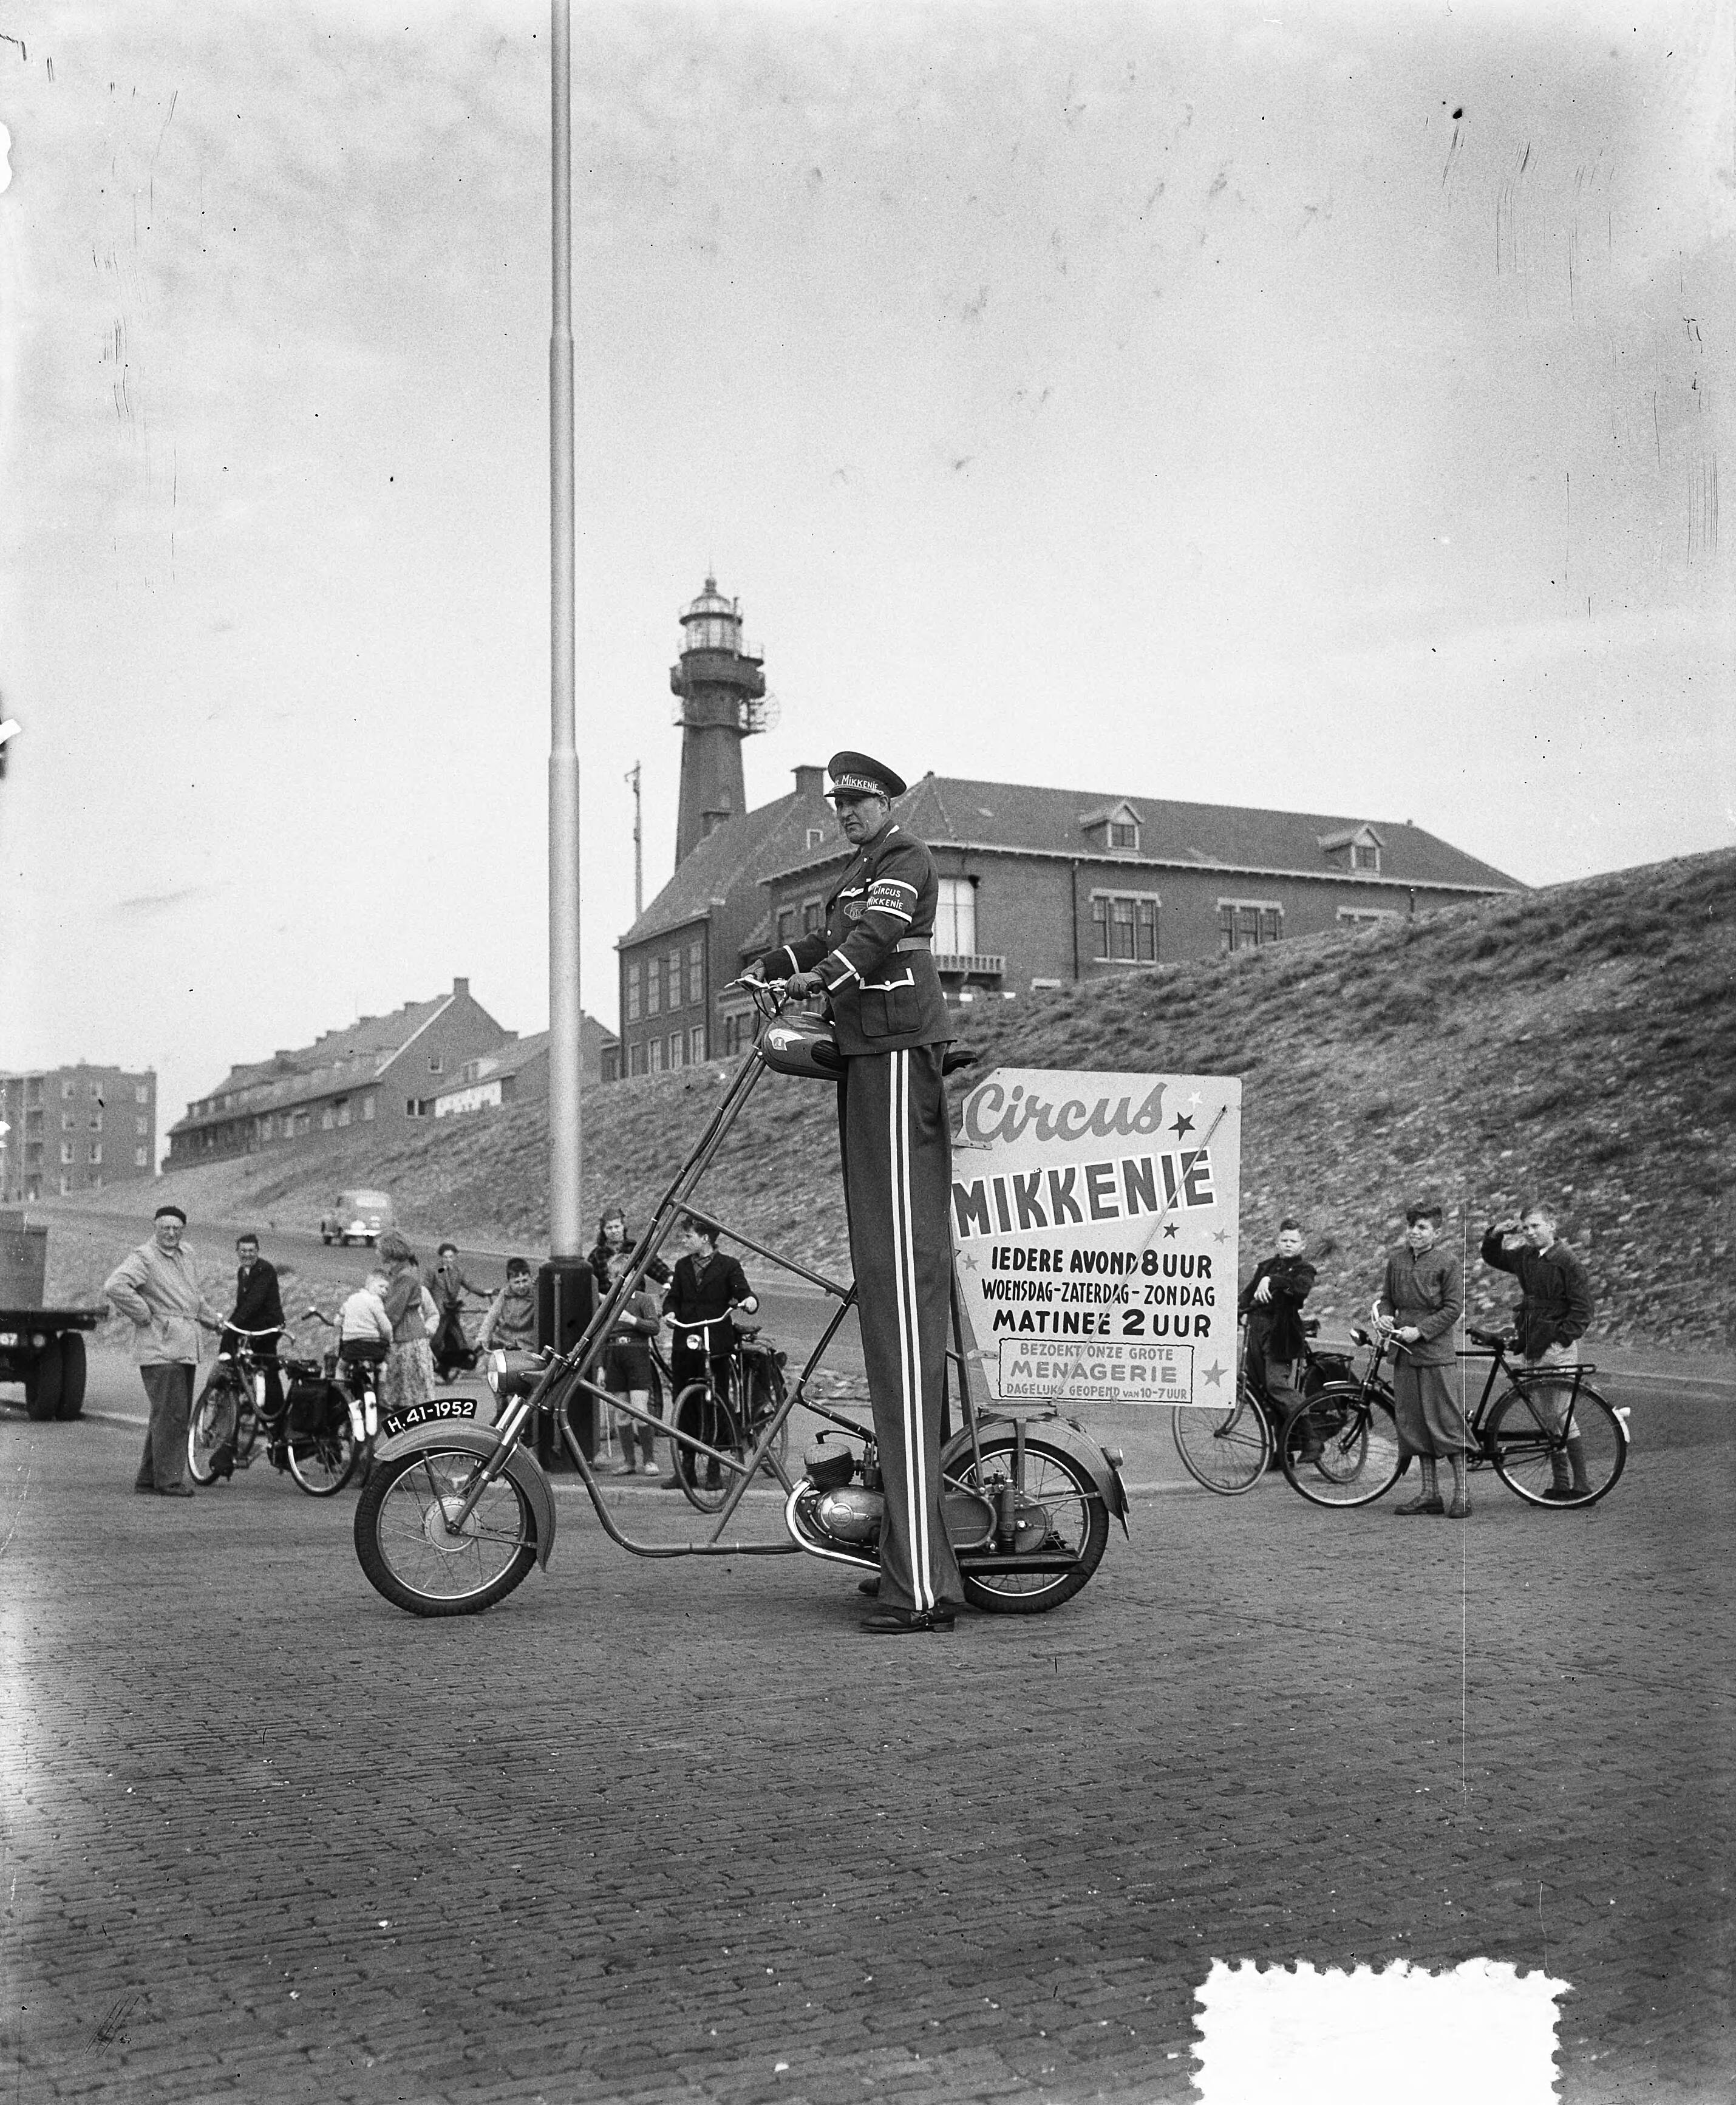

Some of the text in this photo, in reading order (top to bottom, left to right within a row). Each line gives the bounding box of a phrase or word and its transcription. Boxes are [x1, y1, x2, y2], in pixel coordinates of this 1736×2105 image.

[966, 1082, 1168, 1143] Circus
[951, 1149, 1213, 1237] MIKKENIE
[992, 1246, 1212, 1279] IEDERE AVOND 8 UUR
[992, 1309, 1211, 1338] MATINEE 2 UUR
[1020, 1343, 1173, 1361] BEZOEKT ONZE GROTE
[1010, 1360, 1177, 1383] MENAGERIE
[1069, 1385, 1120, 1397] GEOPEND
[387, 1401, 474, 1433] H.41-1952
